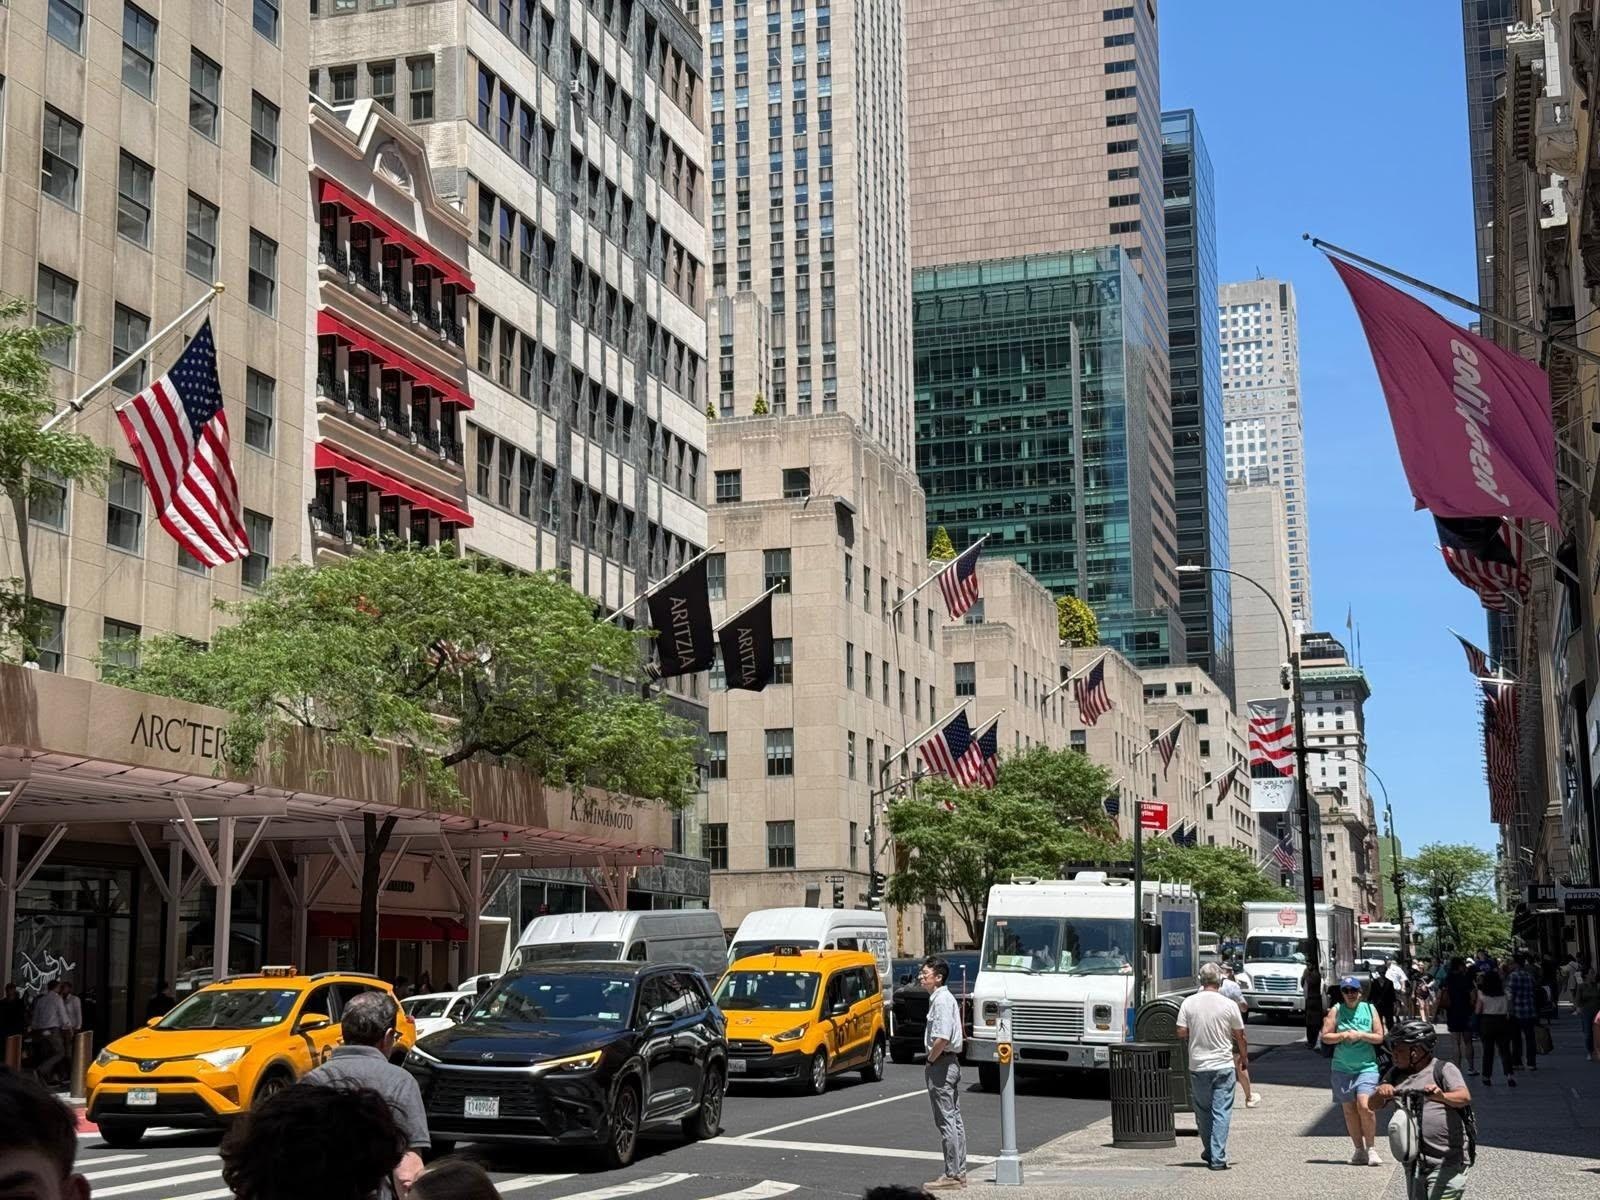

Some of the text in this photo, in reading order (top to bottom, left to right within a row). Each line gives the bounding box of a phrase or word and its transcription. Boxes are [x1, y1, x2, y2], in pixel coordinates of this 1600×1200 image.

[670, 597, 696, 668] ARITZIA
[737, 628, 757, 686] ARITZIA
[131, 712, 228, 761] ARC'TER
[1537, 887, 1555, 899] PU
